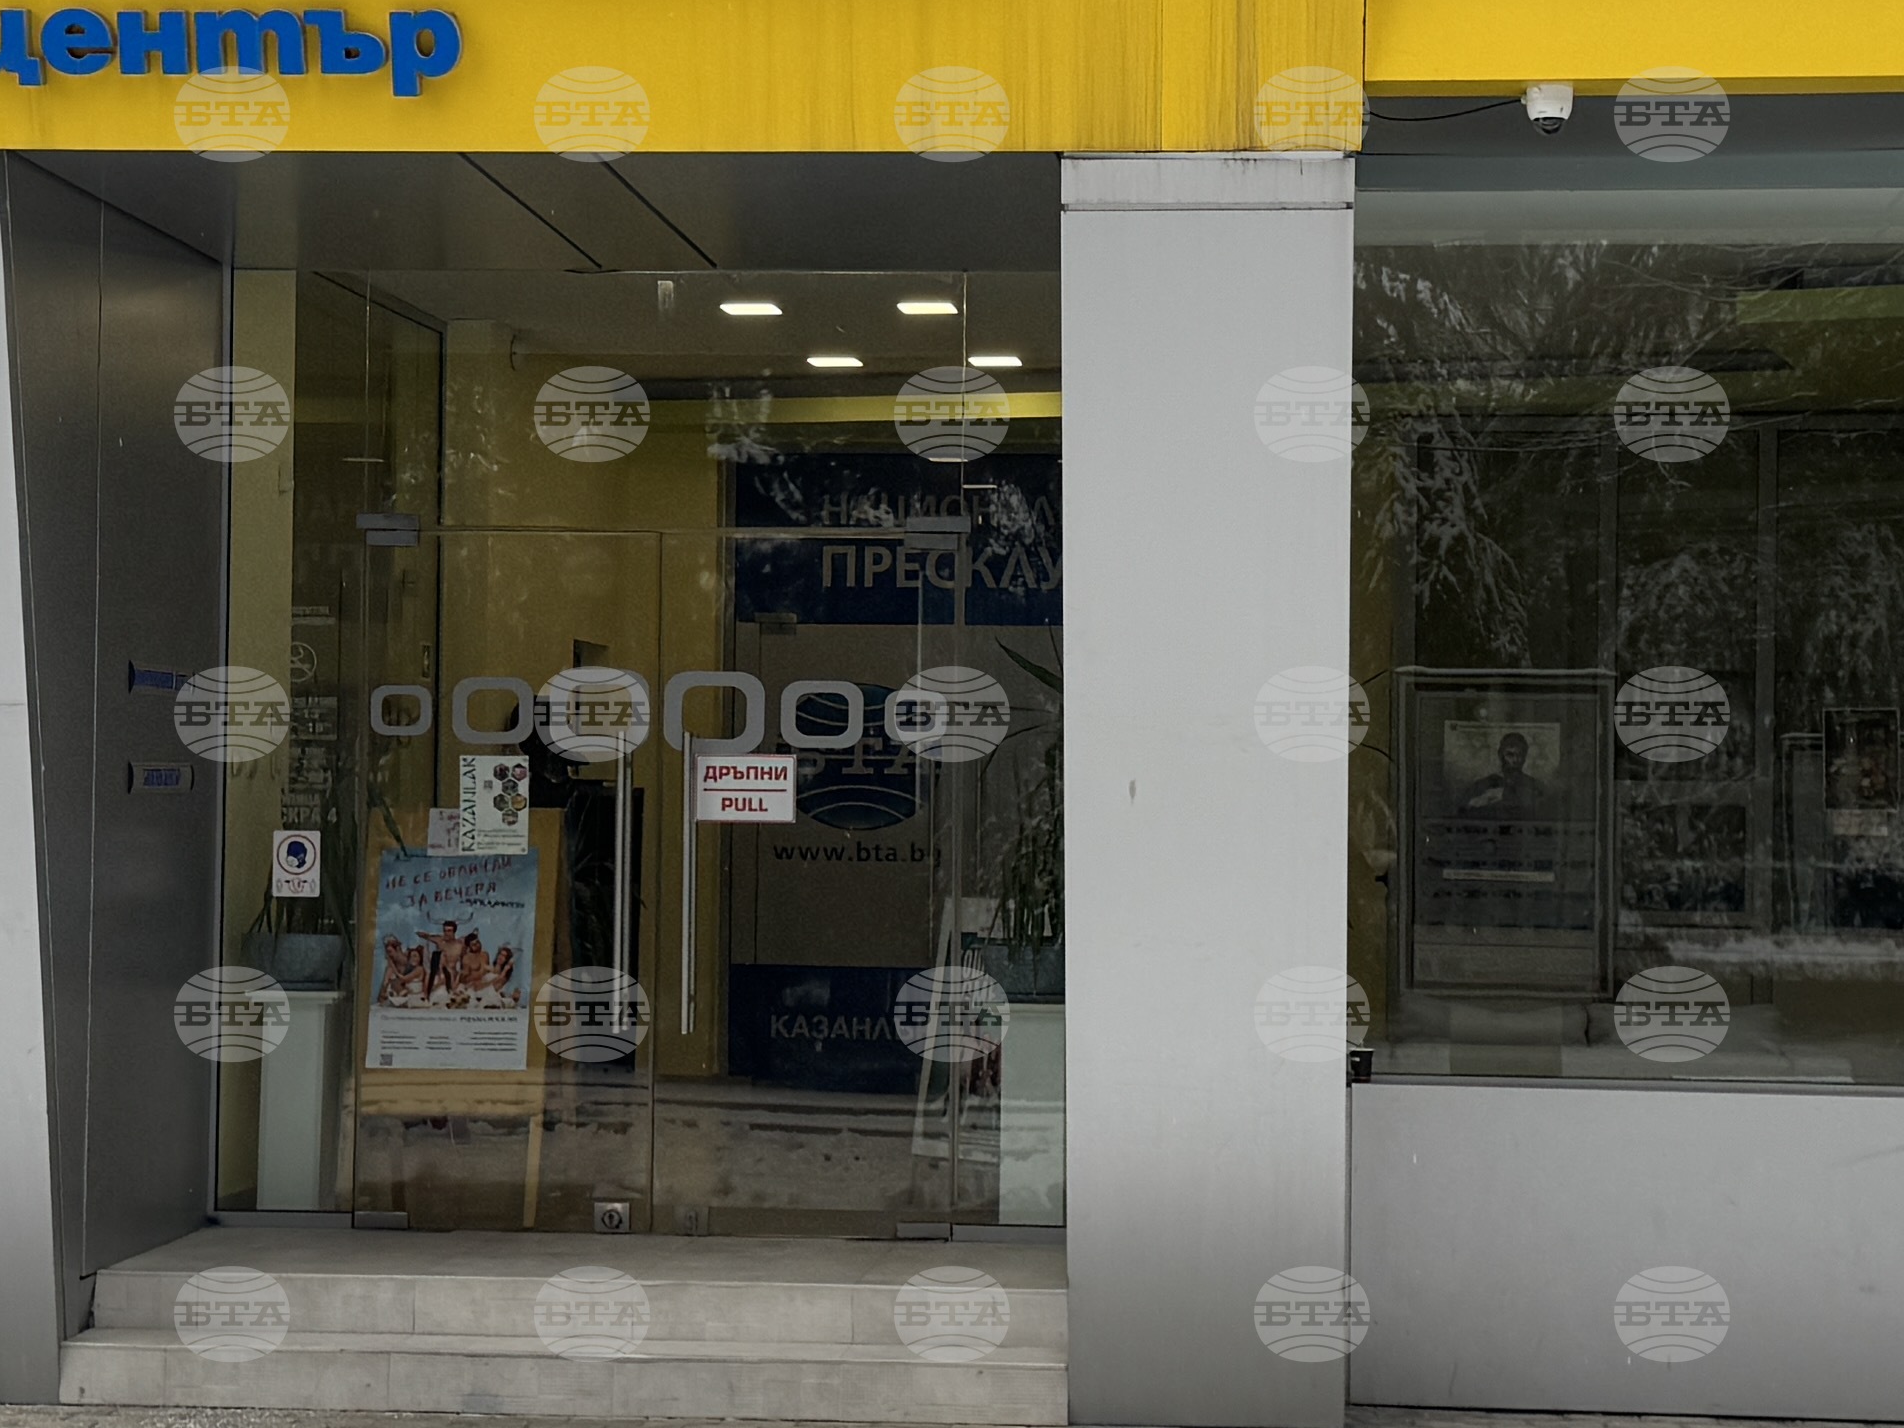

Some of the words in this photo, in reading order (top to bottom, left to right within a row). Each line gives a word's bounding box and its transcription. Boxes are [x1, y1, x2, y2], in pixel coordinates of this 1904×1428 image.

[703, 765, 788, 782] ДРЪПНИ
[721, 797, 768, 812] PULL
[774, 841, 942, 868] www.bta.bg
